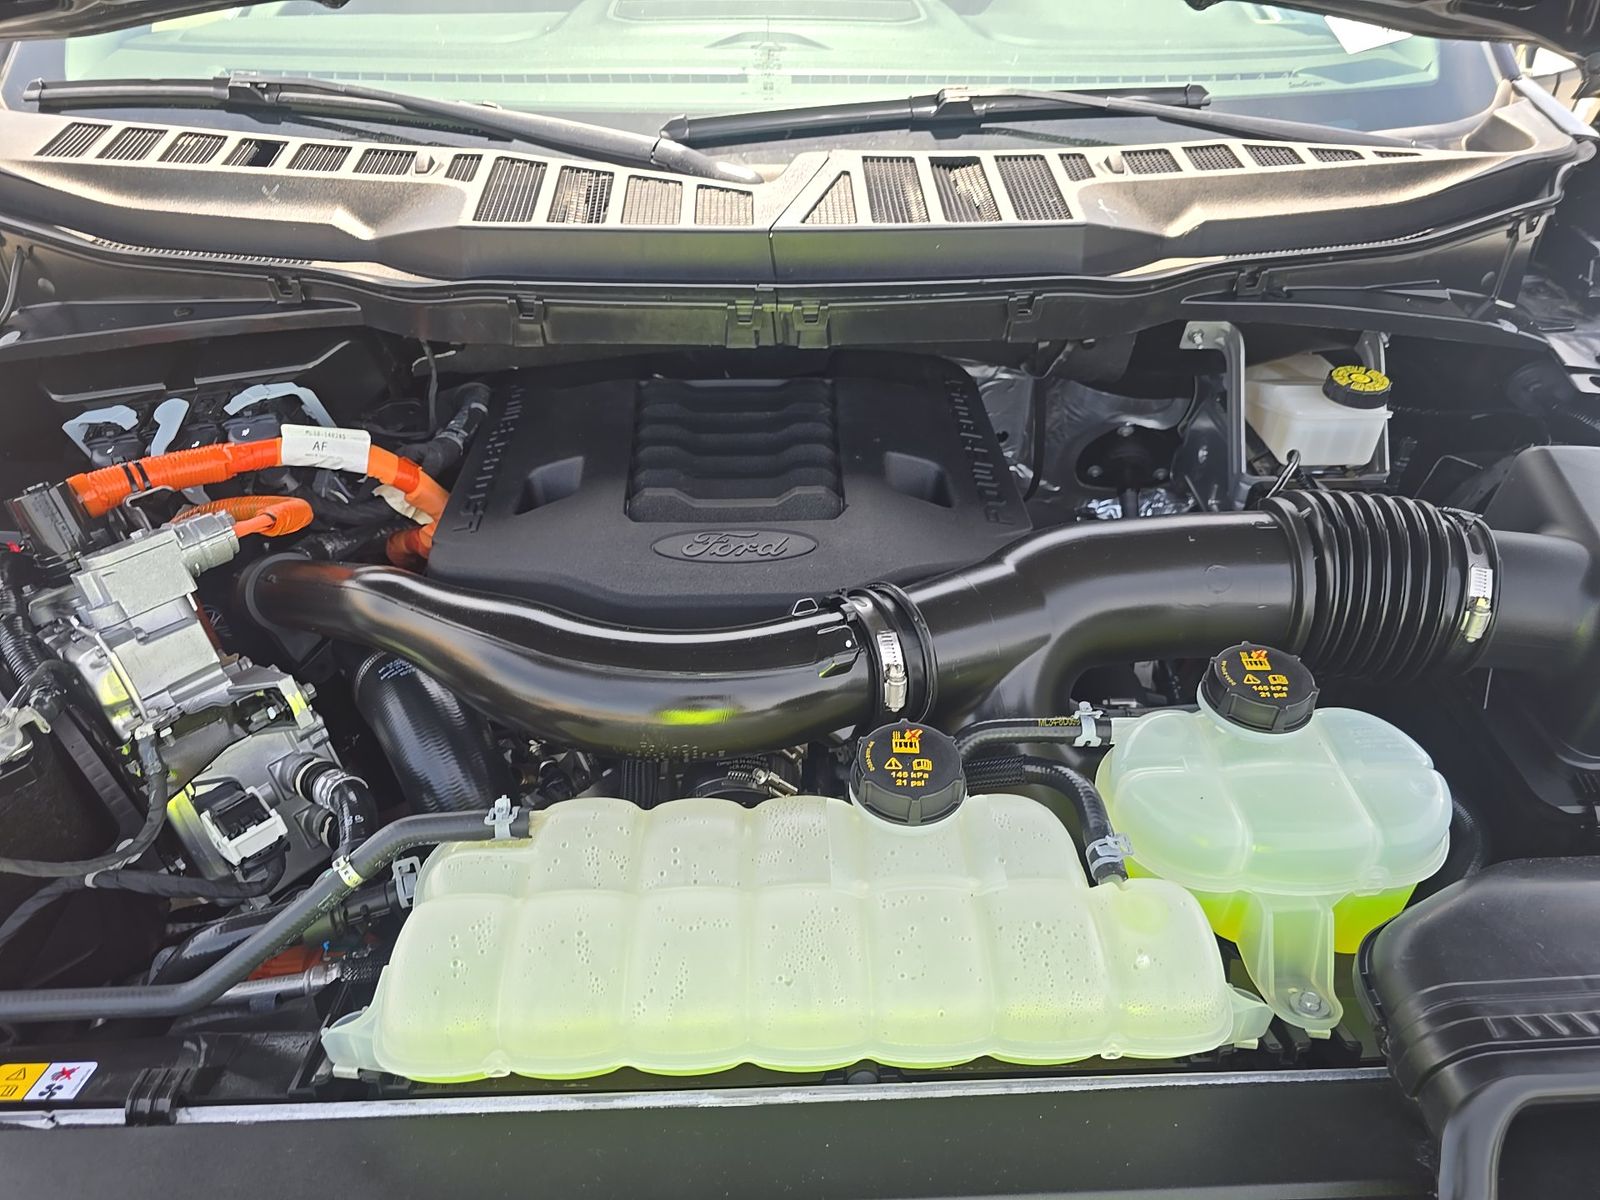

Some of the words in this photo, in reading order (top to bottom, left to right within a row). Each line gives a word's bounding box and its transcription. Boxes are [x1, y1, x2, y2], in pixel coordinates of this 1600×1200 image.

[312, 441, 328, 451] AF
[681, 531, 790, 557] Ford
[890, 771, 909, 779] 145
[910, 771, 929, 779] kPa
[895, 779, 907, 787] 21
[910, 779, 925, 788] psi
